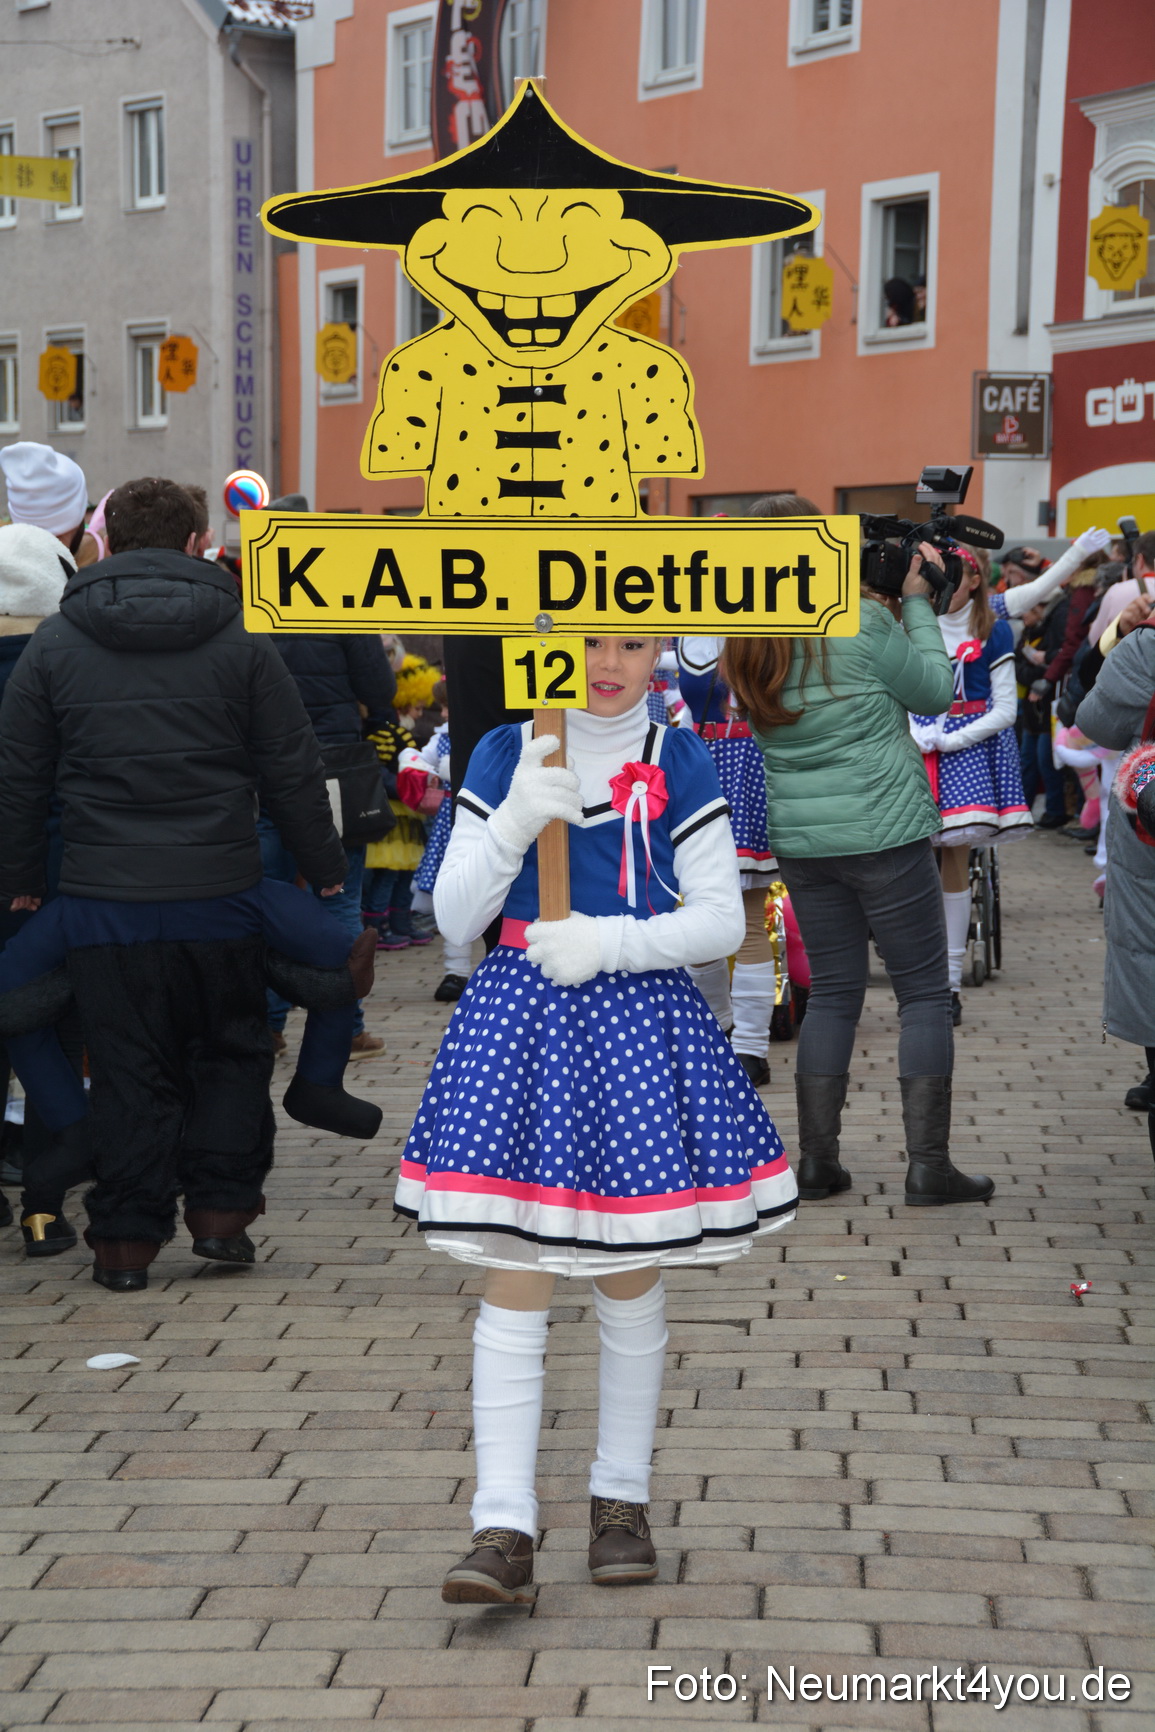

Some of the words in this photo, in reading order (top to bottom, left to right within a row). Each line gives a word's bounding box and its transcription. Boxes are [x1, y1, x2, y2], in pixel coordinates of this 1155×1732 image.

[235, 143, 254, 273] UHREN
[235, 294, 254, 470] SCHMUCK
[983, 380, 1041, 413] CAFÉ
[278, 547, 508, 611] K.A.B.
[538, 549, 816, 615] Dietfurt
[514, 649, 577, 700] 12
